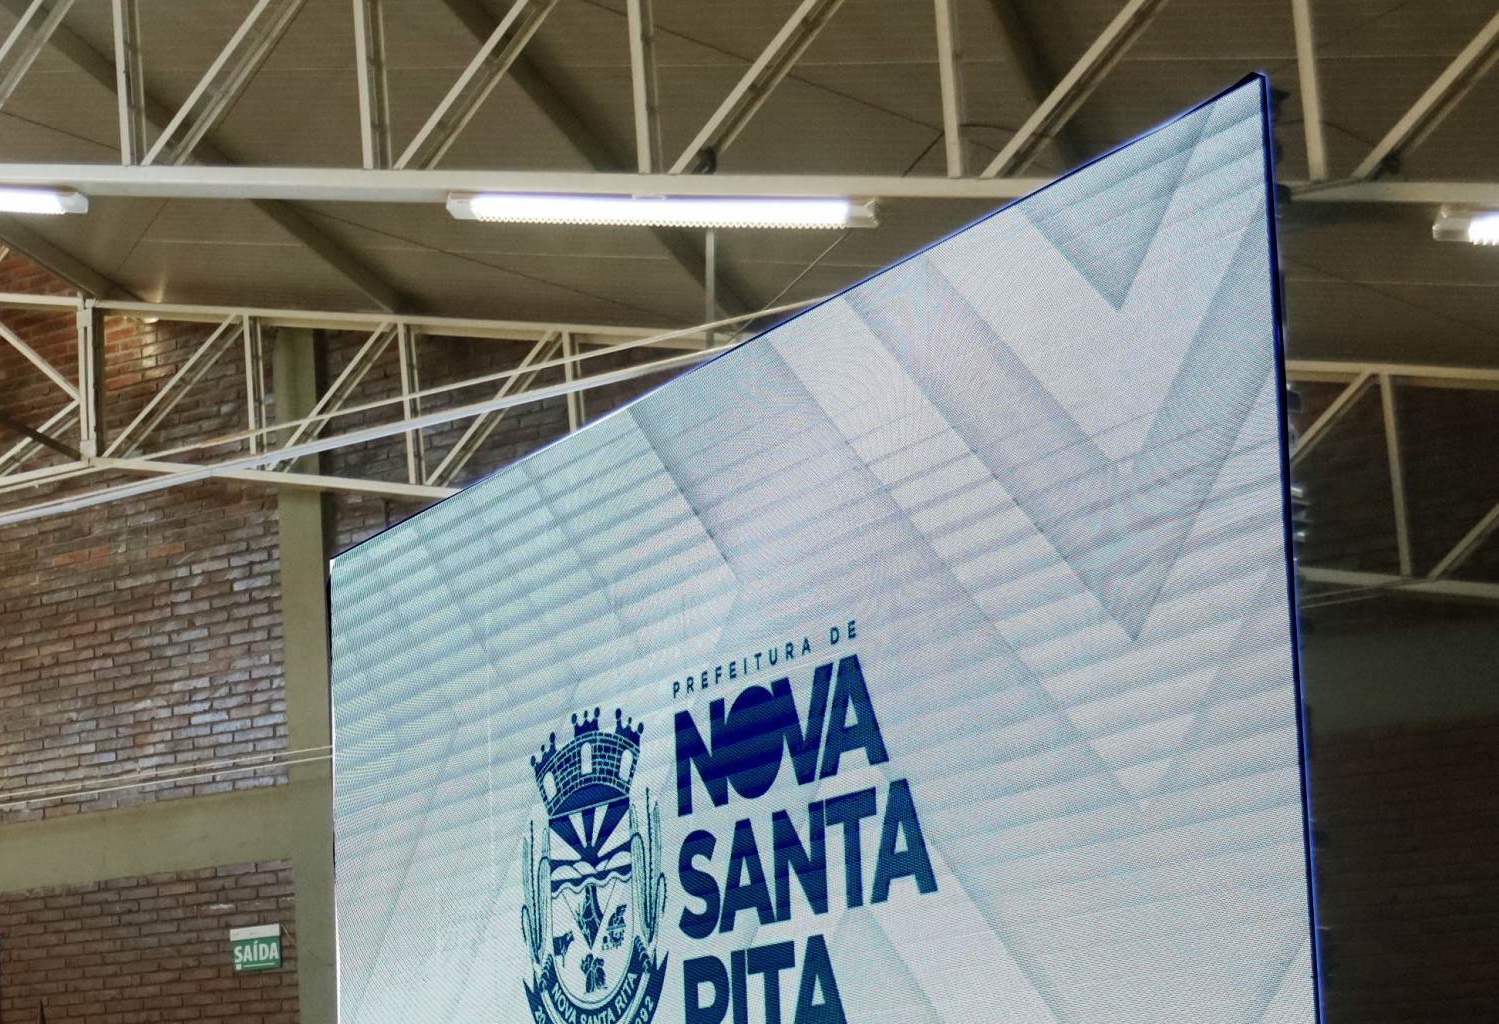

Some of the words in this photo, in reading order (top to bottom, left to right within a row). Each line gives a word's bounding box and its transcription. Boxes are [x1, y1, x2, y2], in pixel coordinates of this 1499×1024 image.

[672, 638, 811, 699] PREFEITURA
[830, 620, 857, 645] DE
[674, 654, 889, 817] NOVA
[678, 778, 938, 939] SANTA
[234, 940, 279, 963] SAÍDA
[614, 973, 638, 1014] RITA
